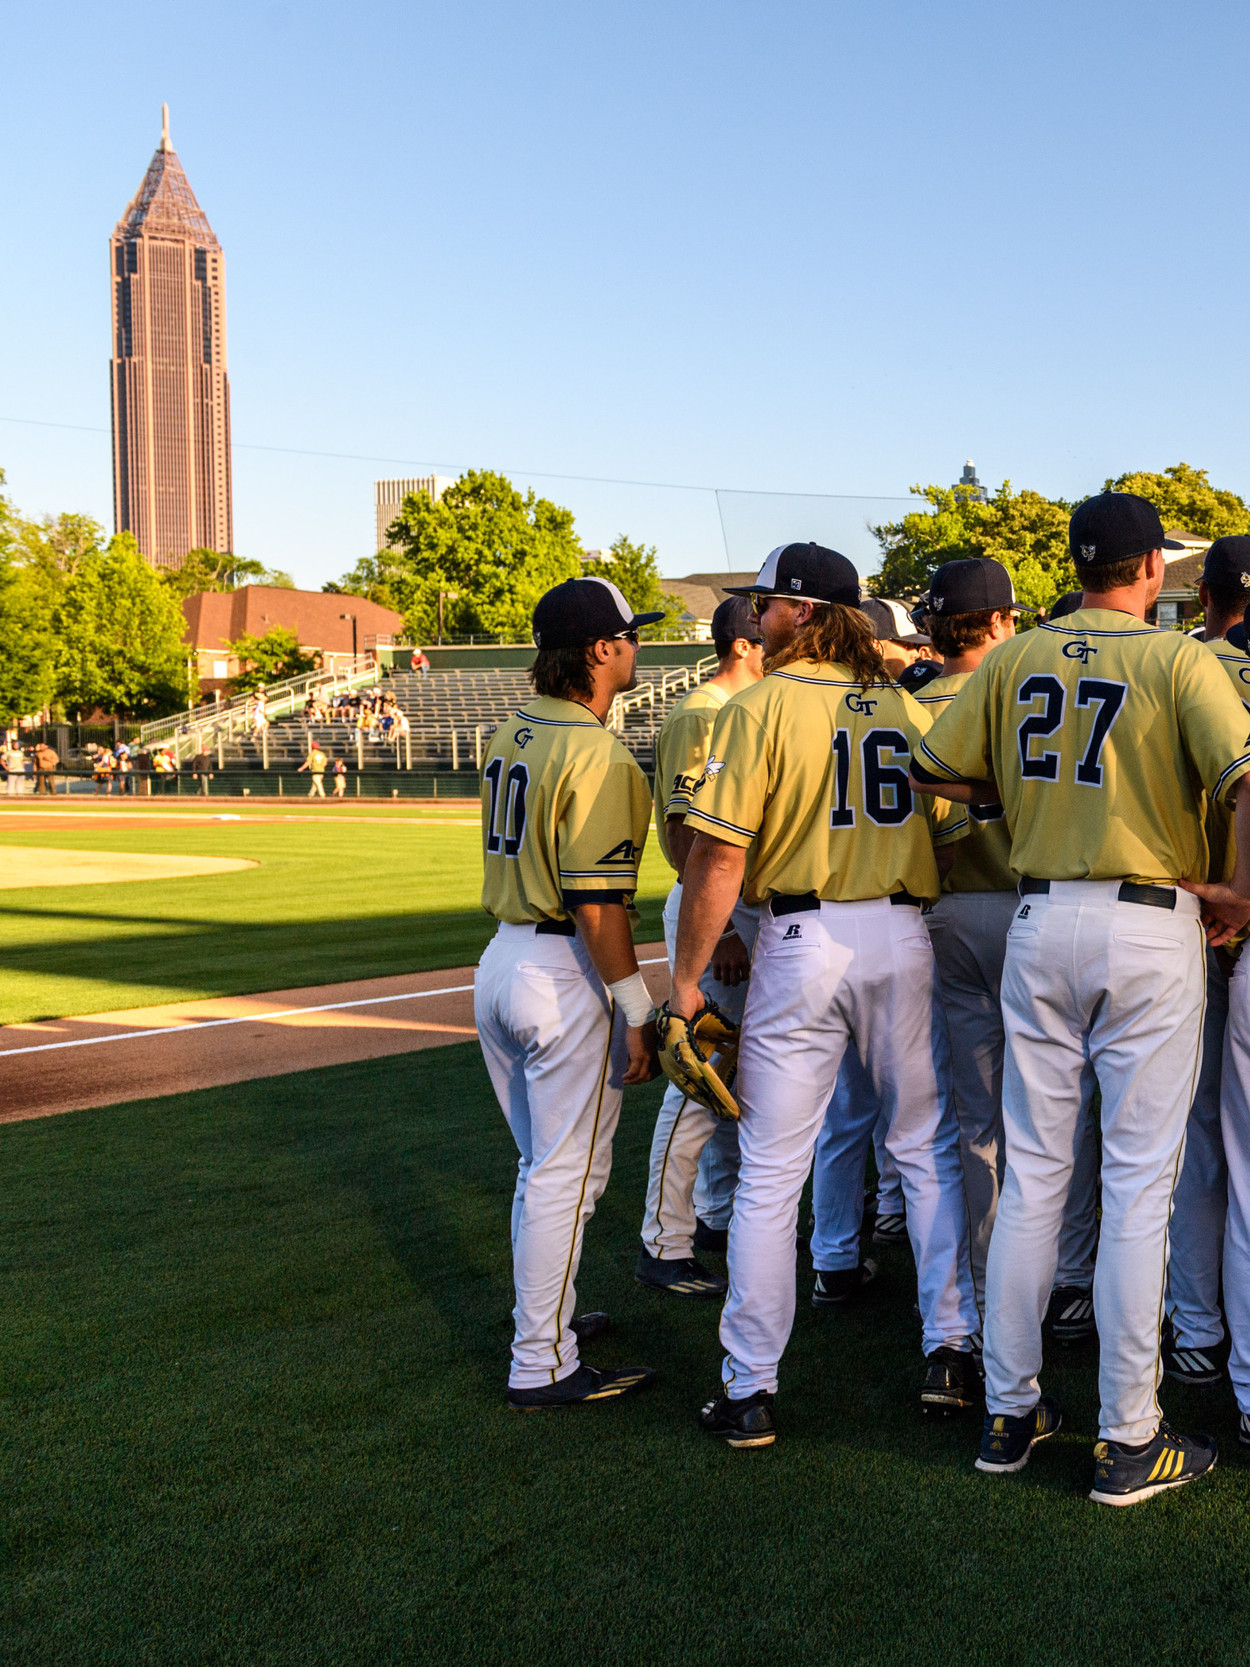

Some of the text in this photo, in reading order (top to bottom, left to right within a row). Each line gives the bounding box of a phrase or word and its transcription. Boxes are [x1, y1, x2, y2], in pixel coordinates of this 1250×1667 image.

[1062, 640, 1098, 664] GT
[845, 693, 878, 716] GT
[1017, 673, 1129, 788] 27
[514, 727, 534, 749] GT
[484, 756, 530, 859] 10
[829, 727, 914, 829] 16
